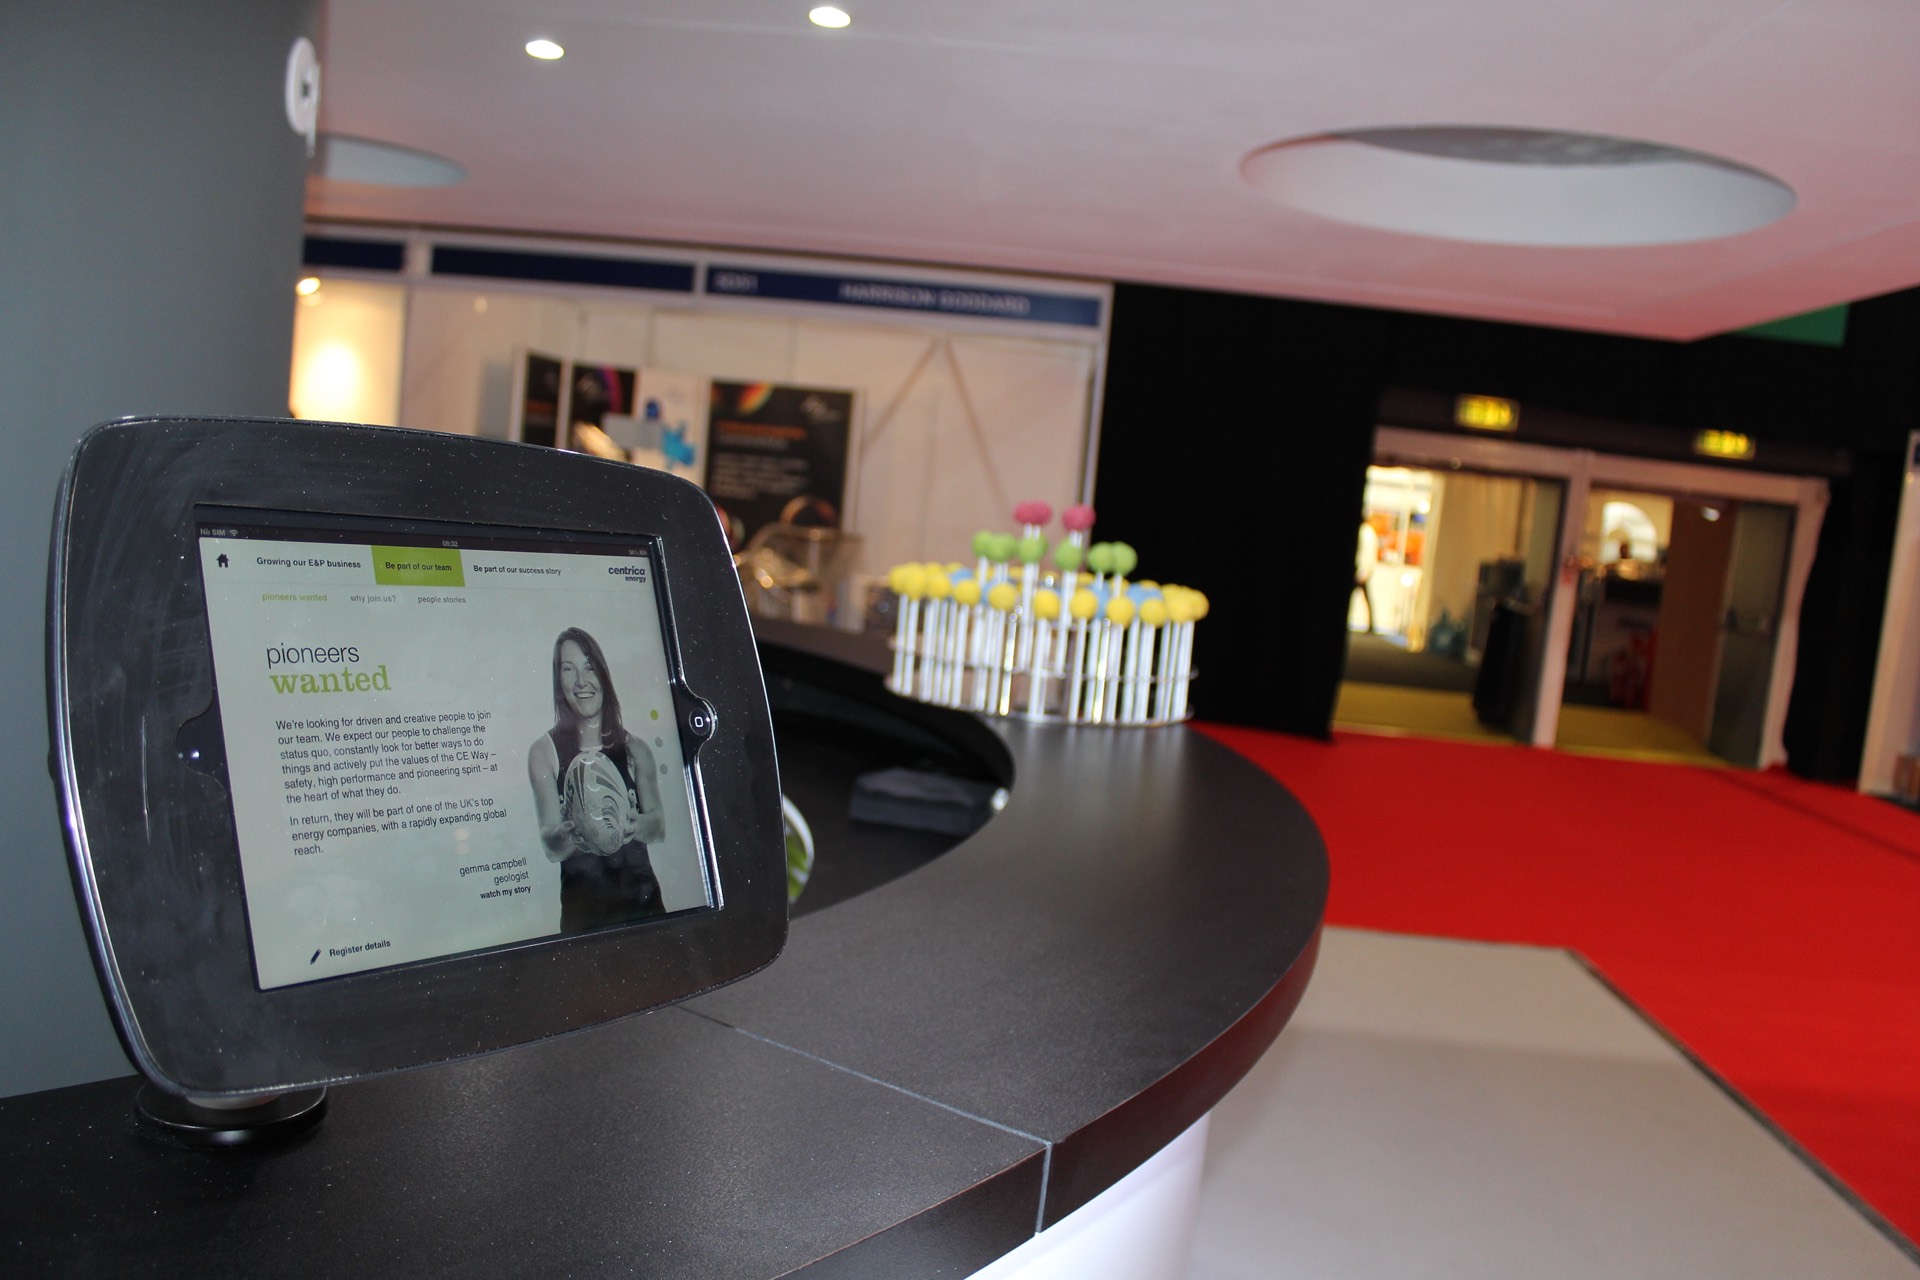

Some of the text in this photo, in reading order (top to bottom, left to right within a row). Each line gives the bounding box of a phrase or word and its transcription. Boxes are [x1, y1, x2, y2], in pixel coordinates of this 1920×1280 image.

[256, 557, 291, 567] Growing
[327, 560, 361, 568] business
[397, 562, 411, 571] part
[434, 563, 452, 571] team
[484, 565, 498, 573] part
[546, 568, 561, 576] story
[608, 566, 645, 575] centrica
[262, 594, 296, 602] pioneers
[350, 595, 365, 604] why
[367, 595, 381, 603] join
[418, 596, 441, 604] people
[266, 642, 360, 669] pioneers
[269, 665, 392, 694] wanted
[276, 711, 491, 730] We're looking for driven and creative people to join
[278, 725, 485, 745] our team. We expect our people to challenge the
[280, 738, 484, 759] status quo, constantly look for better ways to do
[282, 764, 310, 775] things
[314, 762, 330, 772] and
[333, 759, 367, 770] actively
[369, 758, 383, 769] put
[385, 757, 399, 766] the
[401, 756, 429, 765] values
[431, 754, 440, 762] of
[441, 753, 454, 762] the
[456, 751, 469, 760] CE
[470, 750, 489, 760] Way
[284, 778, 316, 789] safety,
[318, 776, 338, 788] high
[340, 772, 396, 786] performance
[399, 770, 414, 780] and
[417, 767, 460, 779] pioneering
[462, 764, 481, 776] spirit
[490, 763, 498, 771] at
[286, 785, 401, 804] the heart of what they do.
[290, 798, 494, 826] In return, they will be part of one of the UK's top
[292, 830, 324, 841] energy
[327, 824, 379, 837] companies,
[381, 821, 399, 831] with
[409, 817, 437, 829] rapidly
[439, 812, 481, 825] expanding
[483, 809, 507, 821] global
[294, 844, 324, 856] reach.
[460, 857, 527, 877] gemma campbell
[494, 871, 529, 886] geologist
[480, 886, 531, 899] watch my story
[329, 940, 391, 957] Register details
